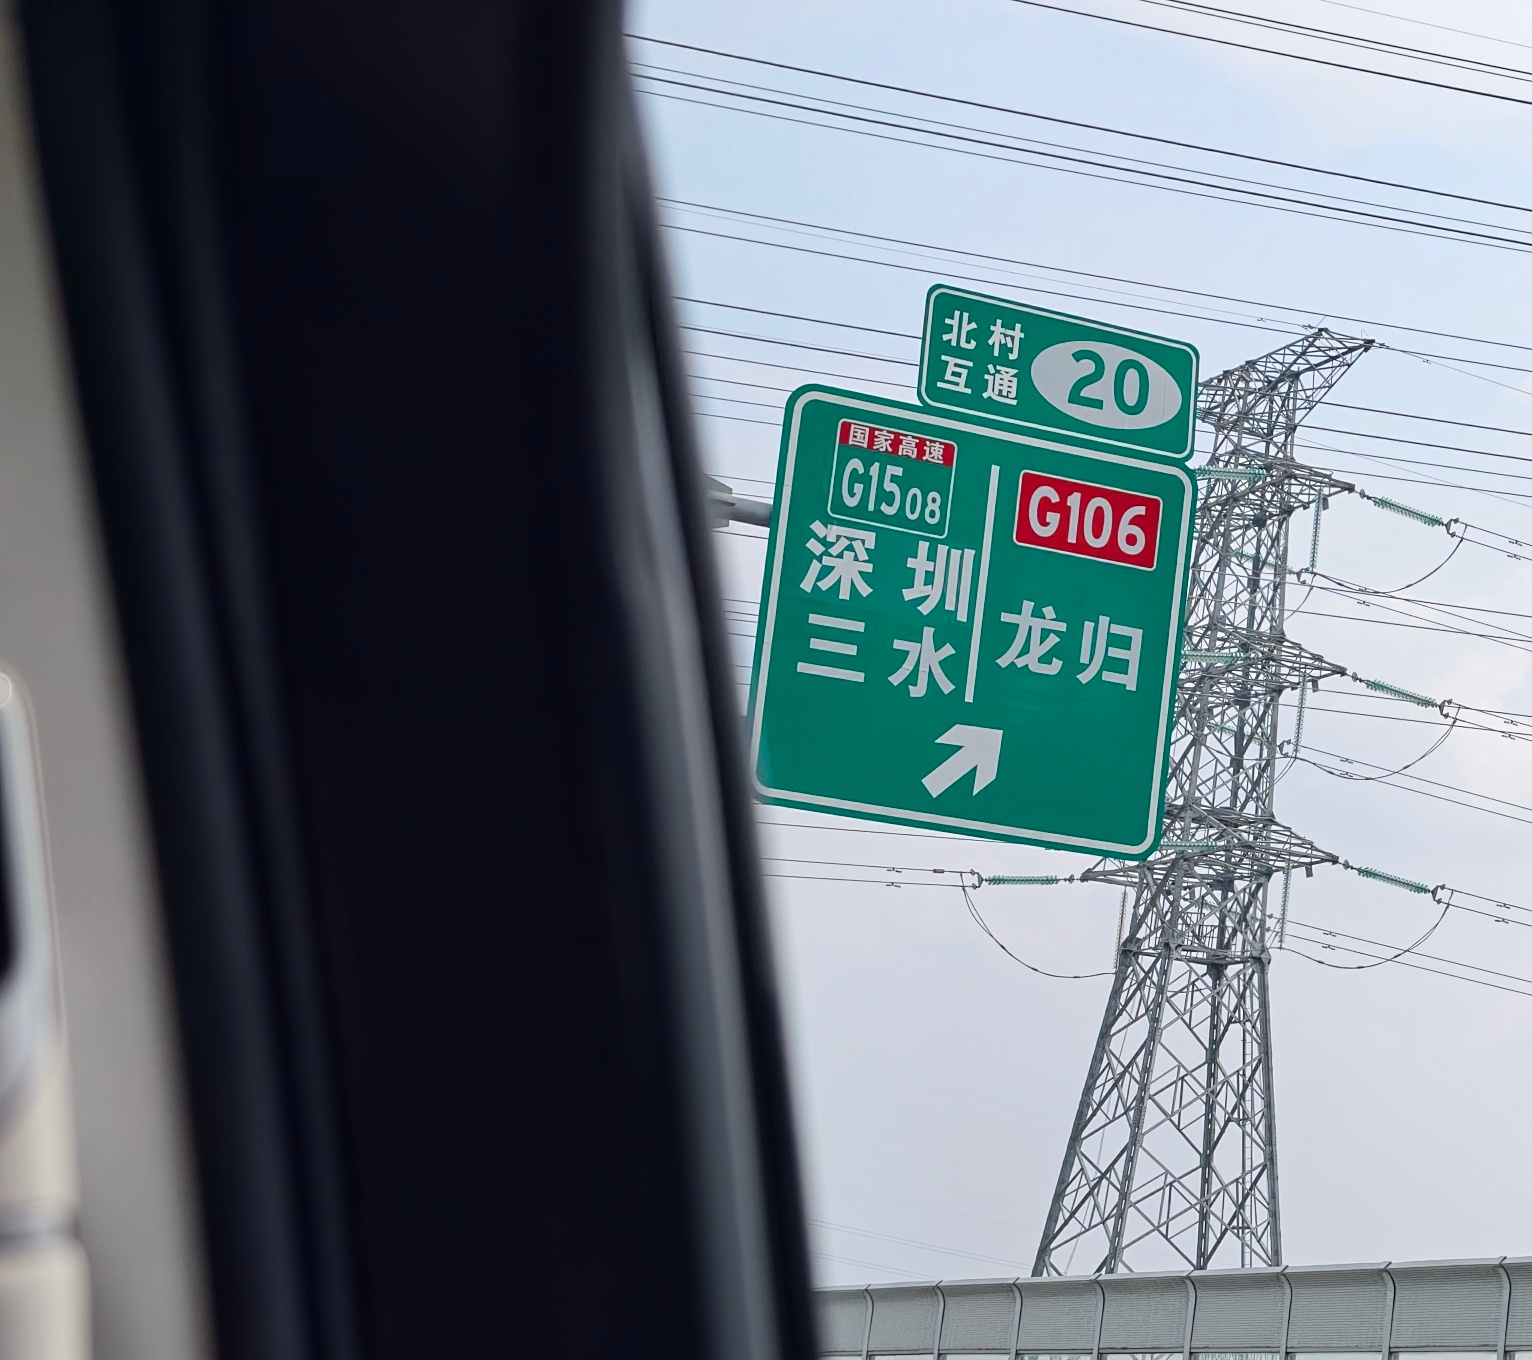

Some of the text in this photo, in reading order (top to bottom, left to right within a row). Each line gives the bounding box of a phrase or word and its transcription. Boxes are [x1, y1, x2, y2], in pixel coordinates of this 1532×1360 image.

[942, 310, 1025, 360] 北村
[937, 355, 1019, 406] 互通
[1066, 348, 1151, 416] 20
[848, 425, 946, 465] 国家高速
[841, 458, 941, 525] G1508
[1029, 485, 1147, 556] G106
[800, 520, 976, 622] 深圳
[796, 613, 956, 698] 三水
[996, 599, 1144, 691] 龙归
